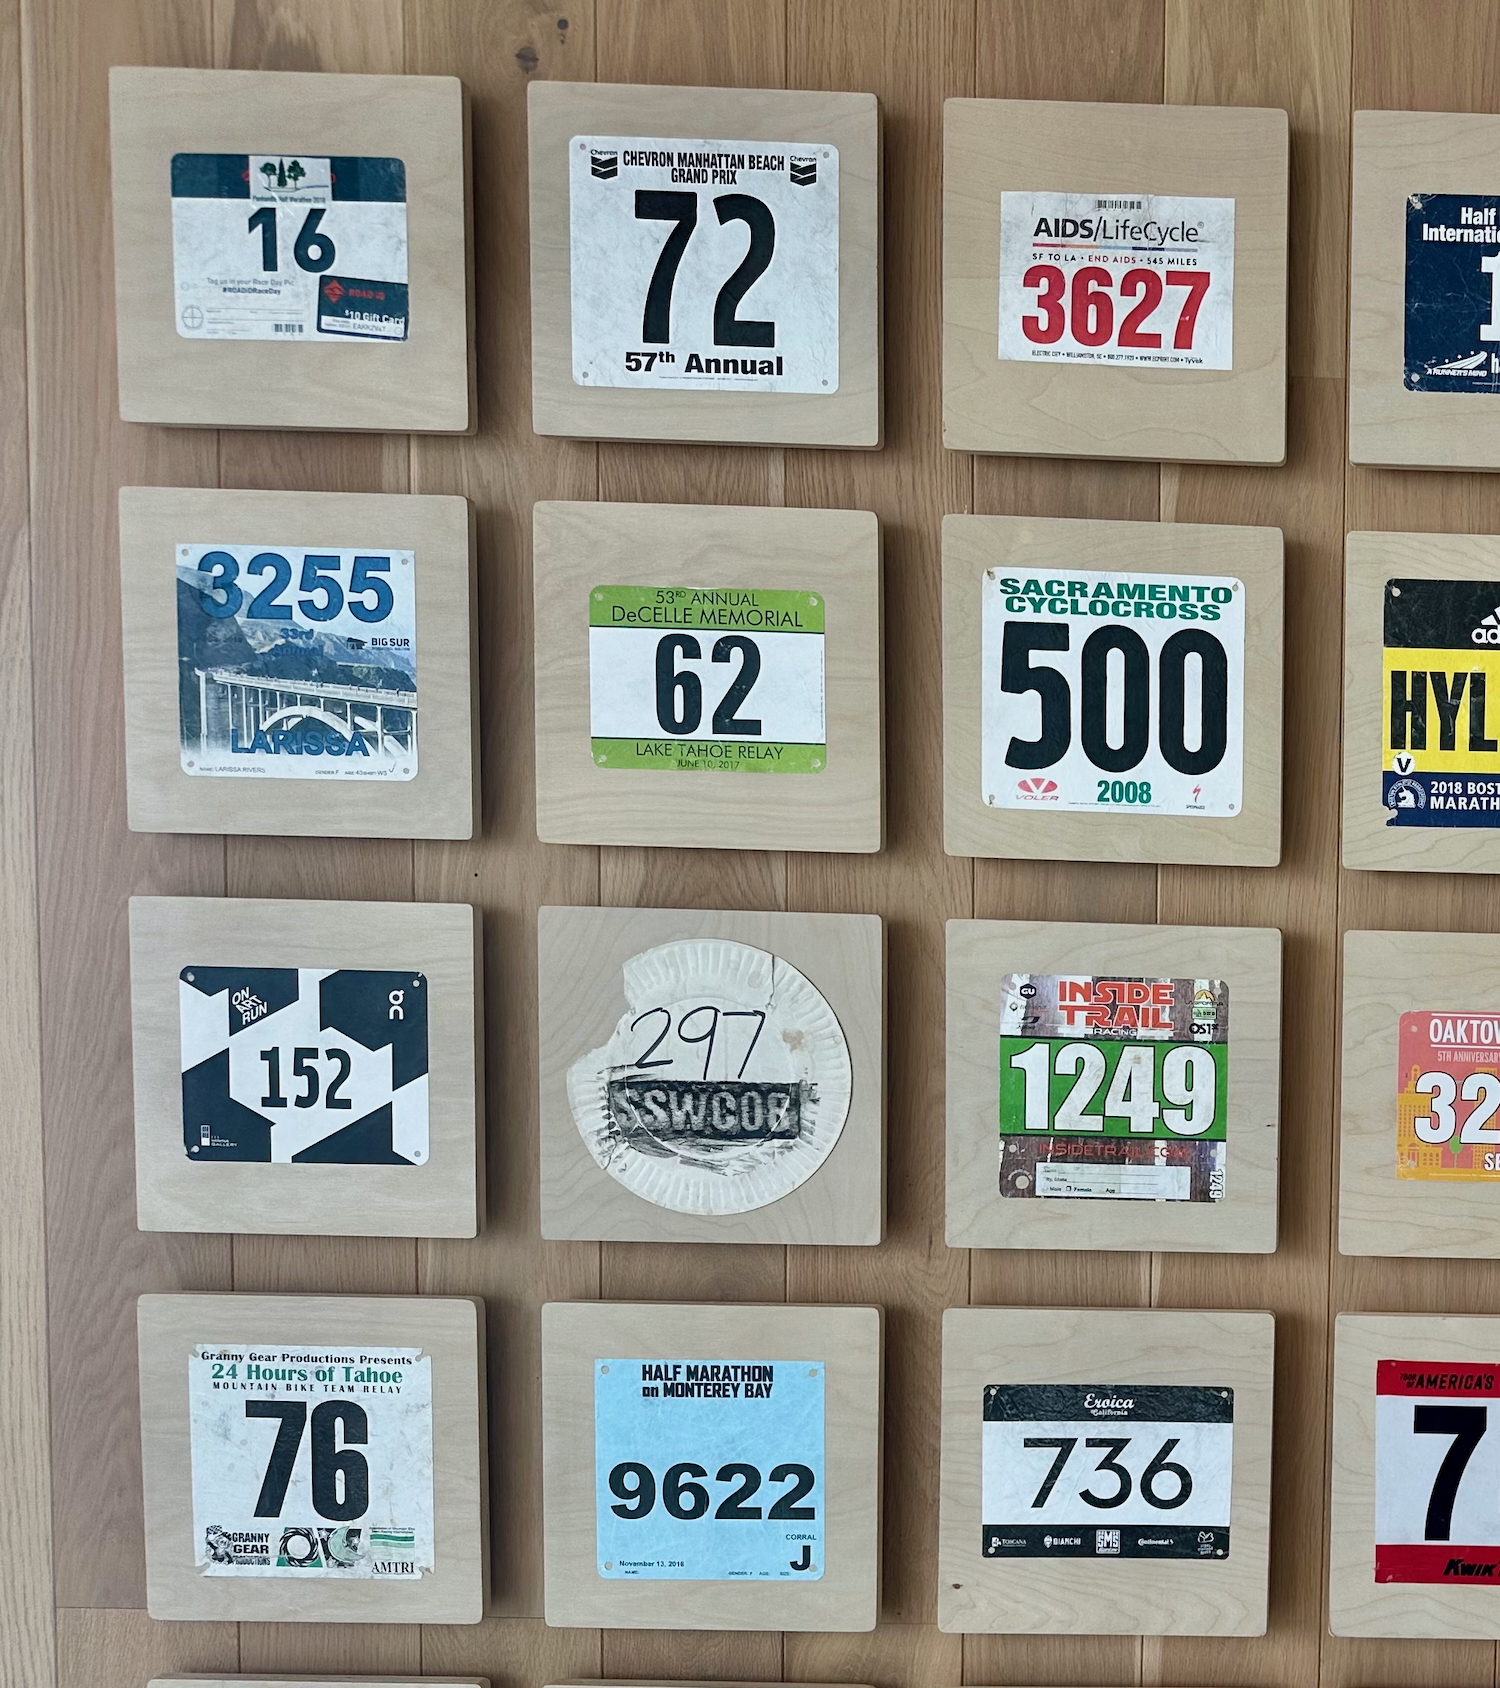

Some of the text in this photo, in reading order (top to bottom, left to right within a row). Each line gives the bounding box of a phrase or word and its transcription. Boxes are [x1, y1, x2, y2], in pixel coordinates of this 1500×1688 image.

[623, 151, 784, 171] CHEVRON MANHATTAN BEACH
[671, 168, 737, 185] GRAND PRIX
[1461, 207, 1496, 225] Half
[248, 208, 335, 273] 16
[635, 190, 775, 348] 72
[1048, 253, 1061, 261] TO
[1147, 257, 1164, 265] 545
[1167, 258, 1197, 266] MILES
[345, 310, 405, 324] $10 Gift Card
[1022, 264, 1211, 350] 3627
[625, 351, 783, 376] 57th Annual
[197, 551, 394, 623] 3255
[1000, 578, 1233, 604] SACRAMENTO
[655, 590, 759, 607] 53RD ANNUAL
[1005, 596, 1221, 621] CYCLOCROSS
[611, 606, 803, 627] DeCELLE MEMORIAL
[372, 638, 410, 646] BIG SUR
[655, 633, 762, 736] 62
[1001, 621, 1228, 776] 500
[231, 728, 370, 757] LARISSA
[636, 743, 783, 760] LAKE TAHOE RELAY
[1396, 758, 1412, 773] V
[1097, 780, 1152, 804] 2008
[1430, 781, 1462, 794] 2018
[232, 987, 249, 1005] ON
[1058, 980, 1175, 1005] INSIDE
[1058, 1004, 1174, 1029] TRAIL
[630, 1005, 766, 1081] 297
[1437, 1051, 1451, 1062] 5TH
[260, 1047, 352, 1110] 152
[1010, 1042, 1217, 1136] 1249
[201, 1352, 413, 1365] Granny Gear Productions Presents
[211, 1363, 403, 1383] 24 Hours of Tahoe
[642, 1364, 774, 1382] HALF MARATHON
[1415, 1373, 1494, 1390] AMERICA'S
[213, 1382, 402, 1394] MOUNTAIN BIKE TEAM RELAY
[642, 1383, 773, 1399] on MONTEREY BAY
[1083, 1393, 1135, 1410] Eroica
[245, 1399, 369, 1522] 76
[1024, 1438, 1193, 1510] 736
[608, 1462, 815, 1521] 9622
[232, 1532, 269, 1543] GRANNY
[233, 1544, 269, 1554] GEAR
[789, 1545, 811, 1571] J
[371, 1561, 415, 1573] AMTRI
